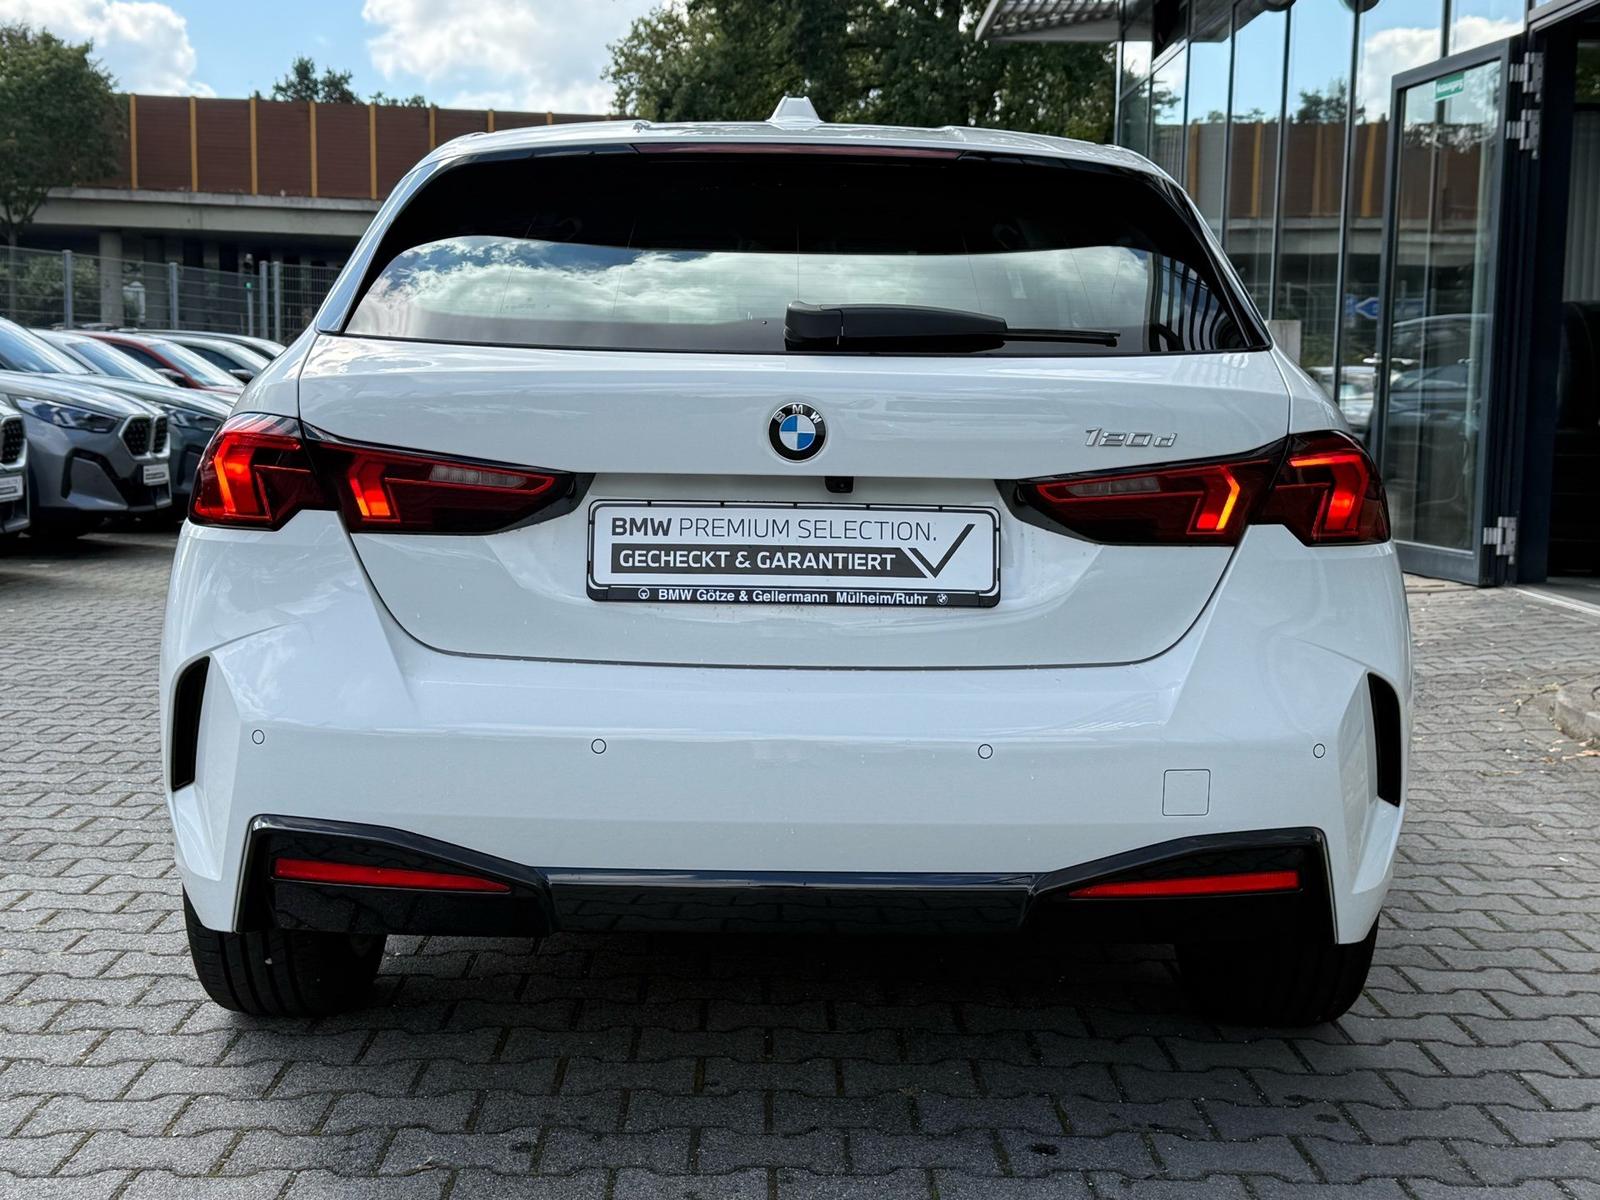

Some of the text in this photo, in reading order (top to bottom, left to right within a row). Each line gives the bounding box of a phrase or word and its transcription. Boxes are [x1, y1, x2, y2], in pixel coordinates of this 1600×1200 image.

[773, 404, 822, 424] BMW
[1085, 428, 1177, 448] 120d
[611, 517, 937, 541] BMW PREMIUM SELECTION.
[619, 550, 896, 570] GECHECKT & GARANTIERT
[658, 588, 928, 605] BMW Götze & Gellermann Mülheim/Ruhr
